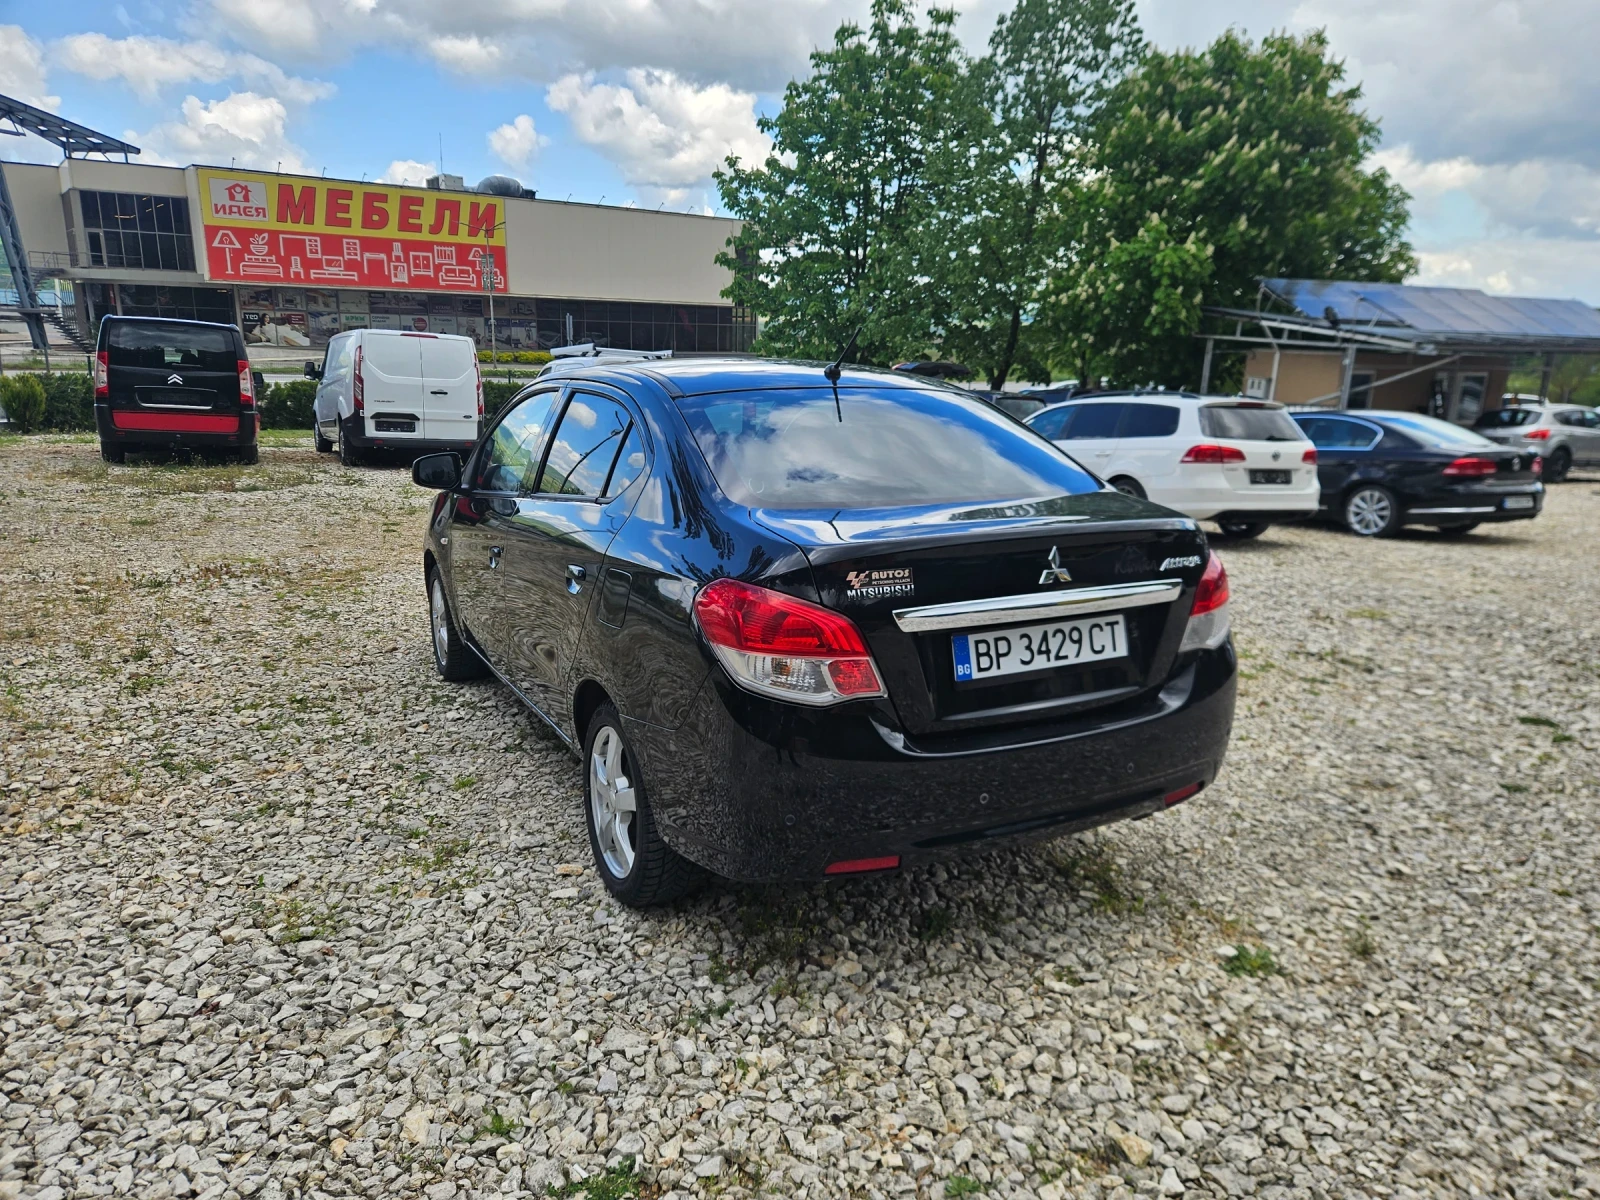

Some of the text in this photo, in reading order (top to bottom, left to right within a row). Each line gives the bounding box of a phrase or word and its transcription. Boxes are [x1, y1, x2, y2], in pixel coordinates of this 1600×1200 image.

[213, 202, 267, 219] ИДЕЯ
[276, 183, 497, 239] МЕБЕЛИ
[871, 569, 910, 580] AUTOS
[847, 584, 915, 602] MITSUBISHI
[974, 621, 1120, 673] BP 3429 CT
[957, 664, 971, 676] BG
